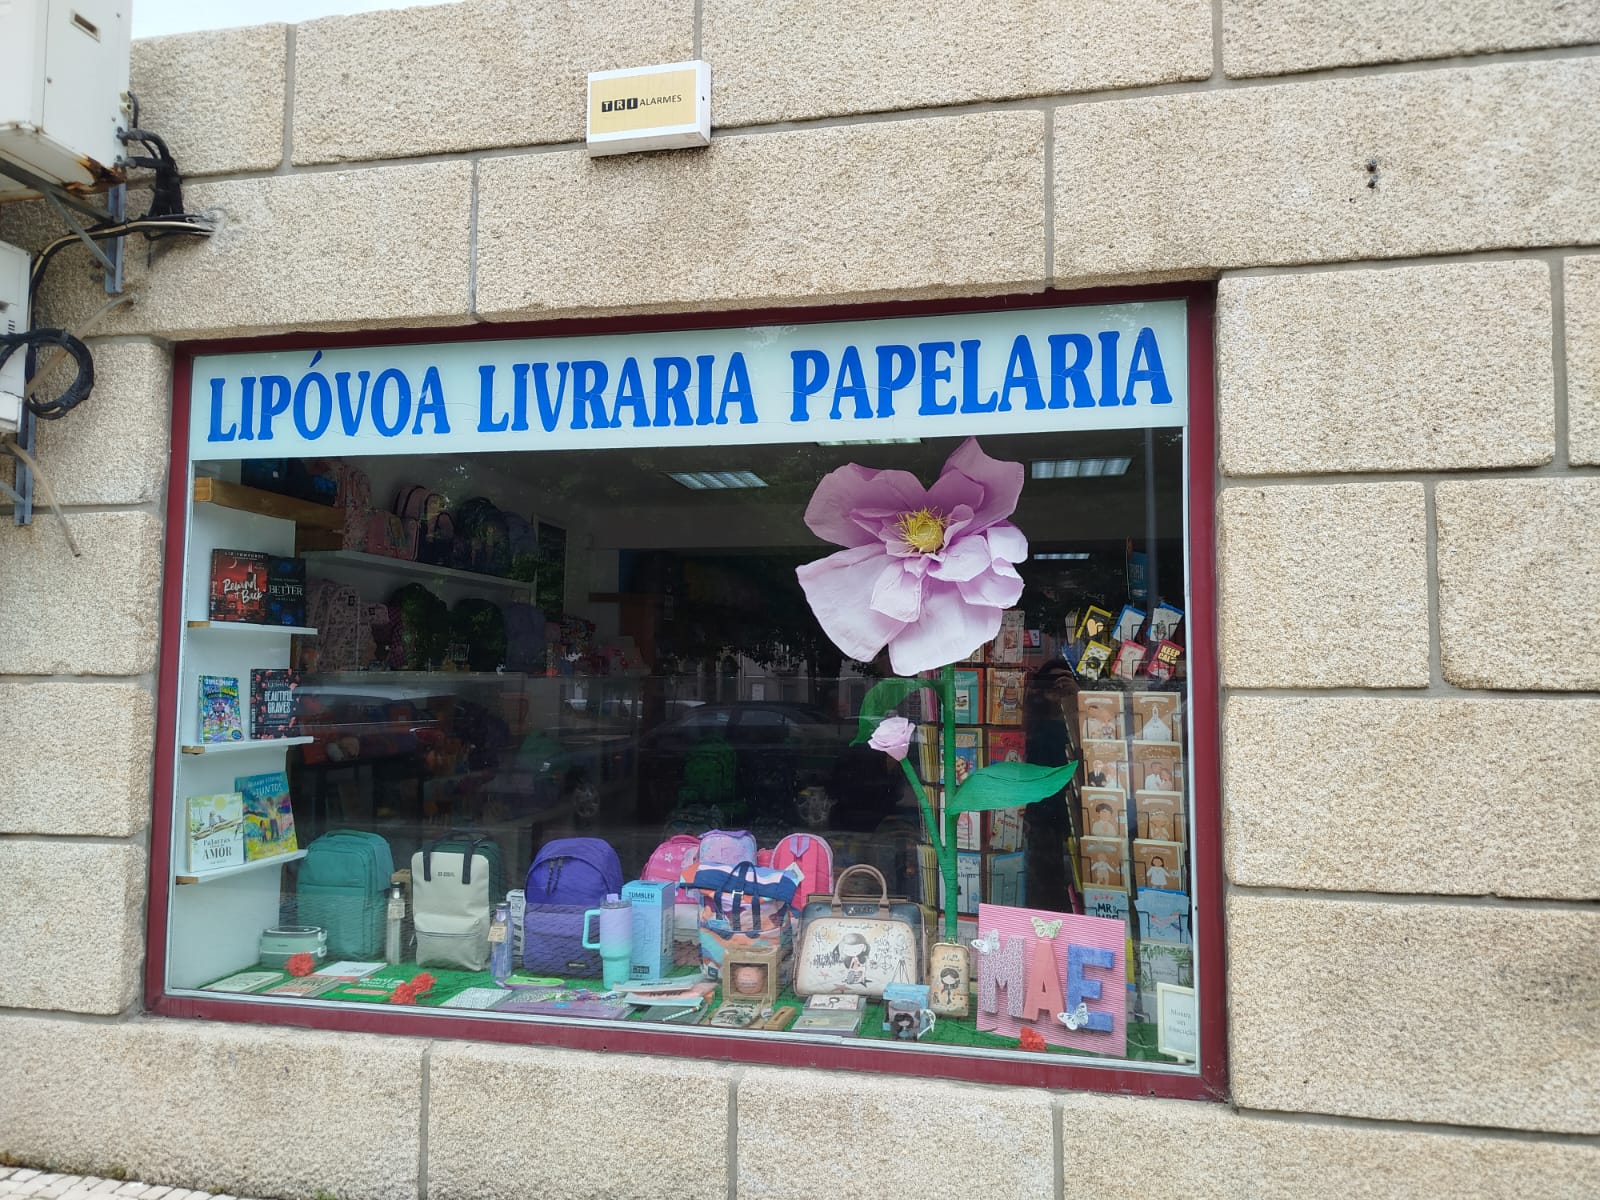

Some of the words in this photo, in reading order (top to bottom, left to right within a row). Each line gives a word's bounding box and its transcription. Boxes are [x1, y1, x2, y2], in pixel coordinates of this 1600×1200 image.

[602, 97, 638, 112] TRI
[639, 94, 682, 106] ALARMES
[207, 350, 450, 443] LIPÓVOA
[477, 352, 758, 433] LIVRARIA
[790, 327, 1173, 423] PAPELARIA
[268, 584, 303, 596] BETTER
[1160, 645, 1181, 657] KEEP
[264, 690, 294, 702] BEAUTIFUL
[267, 701, 291, 714] GRAVES
[255, 783, 283, 798] JUNTOS
[202, 846, 232, 860] AMOR
[628, 891, 655, 899] TUMBLER
[1097, 902, 1112, 913] MR
